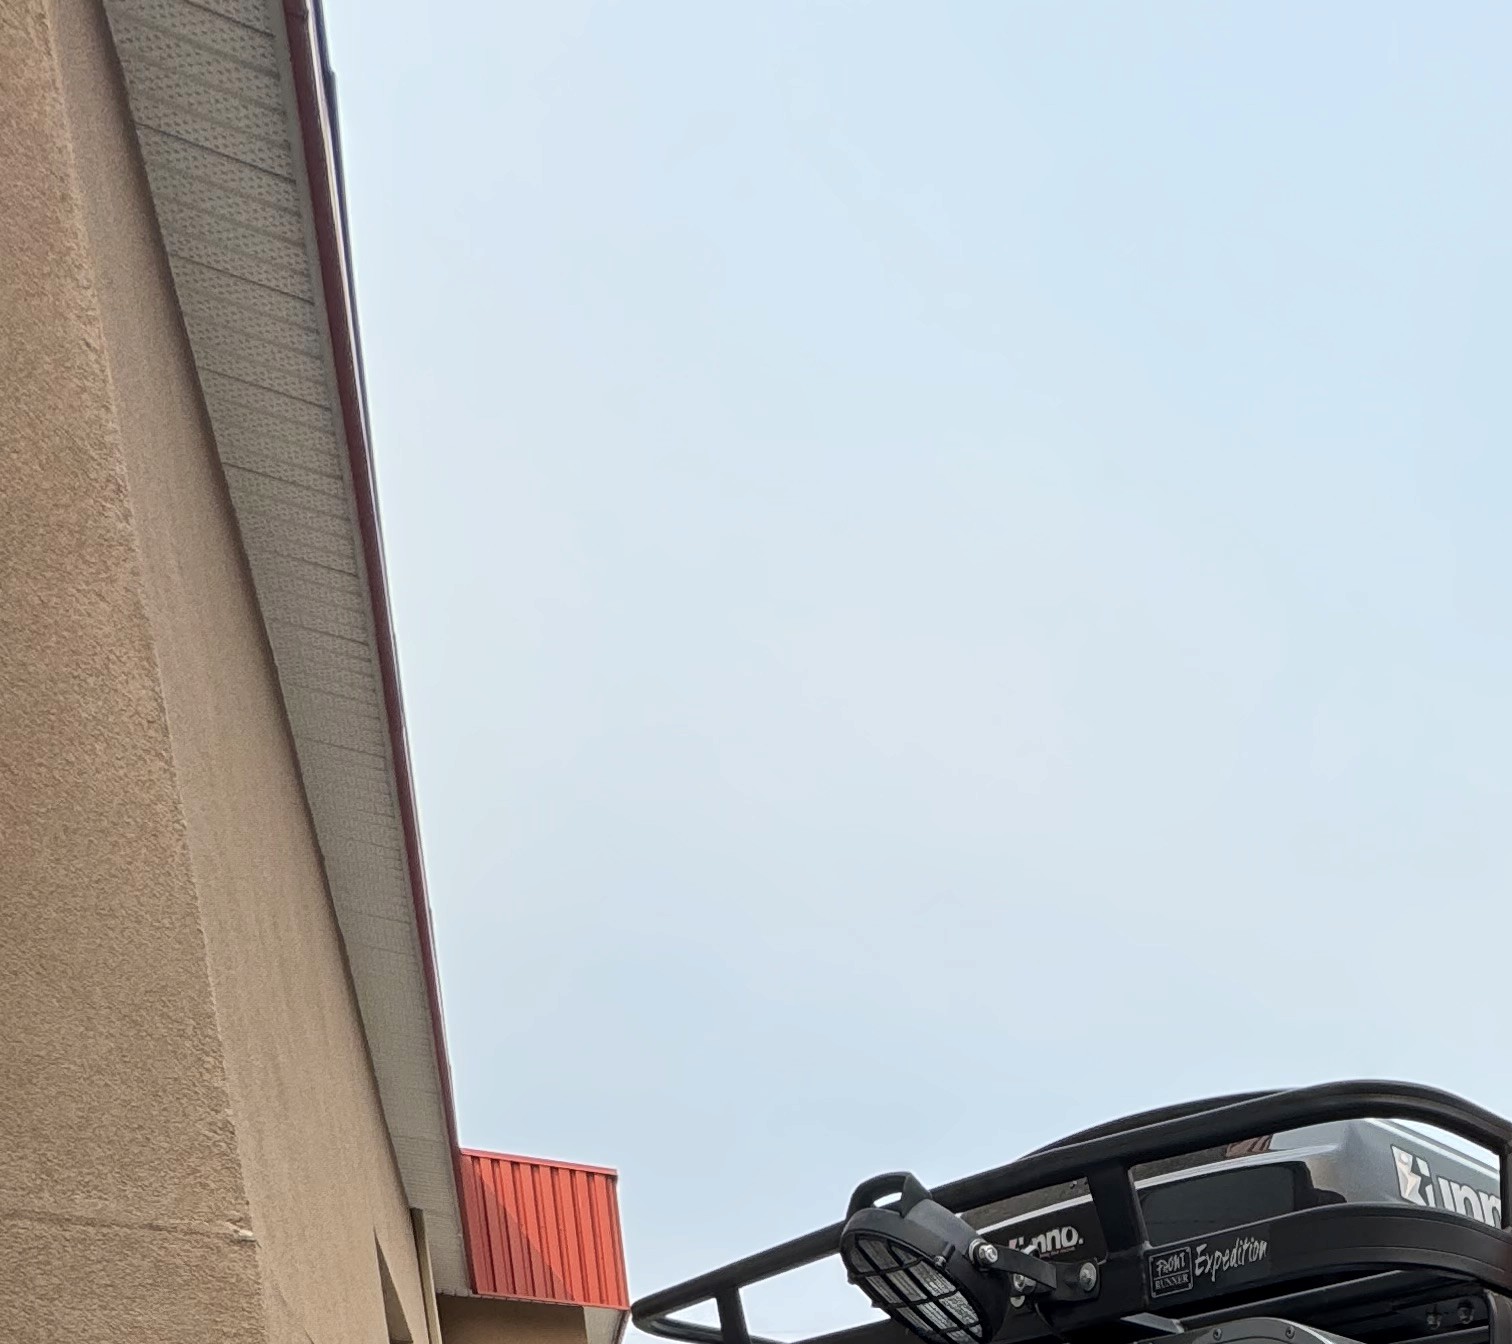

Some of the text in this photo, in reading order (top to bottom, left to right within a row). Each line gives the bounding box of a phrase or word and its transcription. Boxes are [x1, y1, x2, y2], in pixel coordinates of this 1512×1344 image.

[1156, 1251, 1186, 1277] FRONT
[1194, 1236, 1268, 1283] Expedition
[1154, 1273, 1189, 1290] RUNNER
